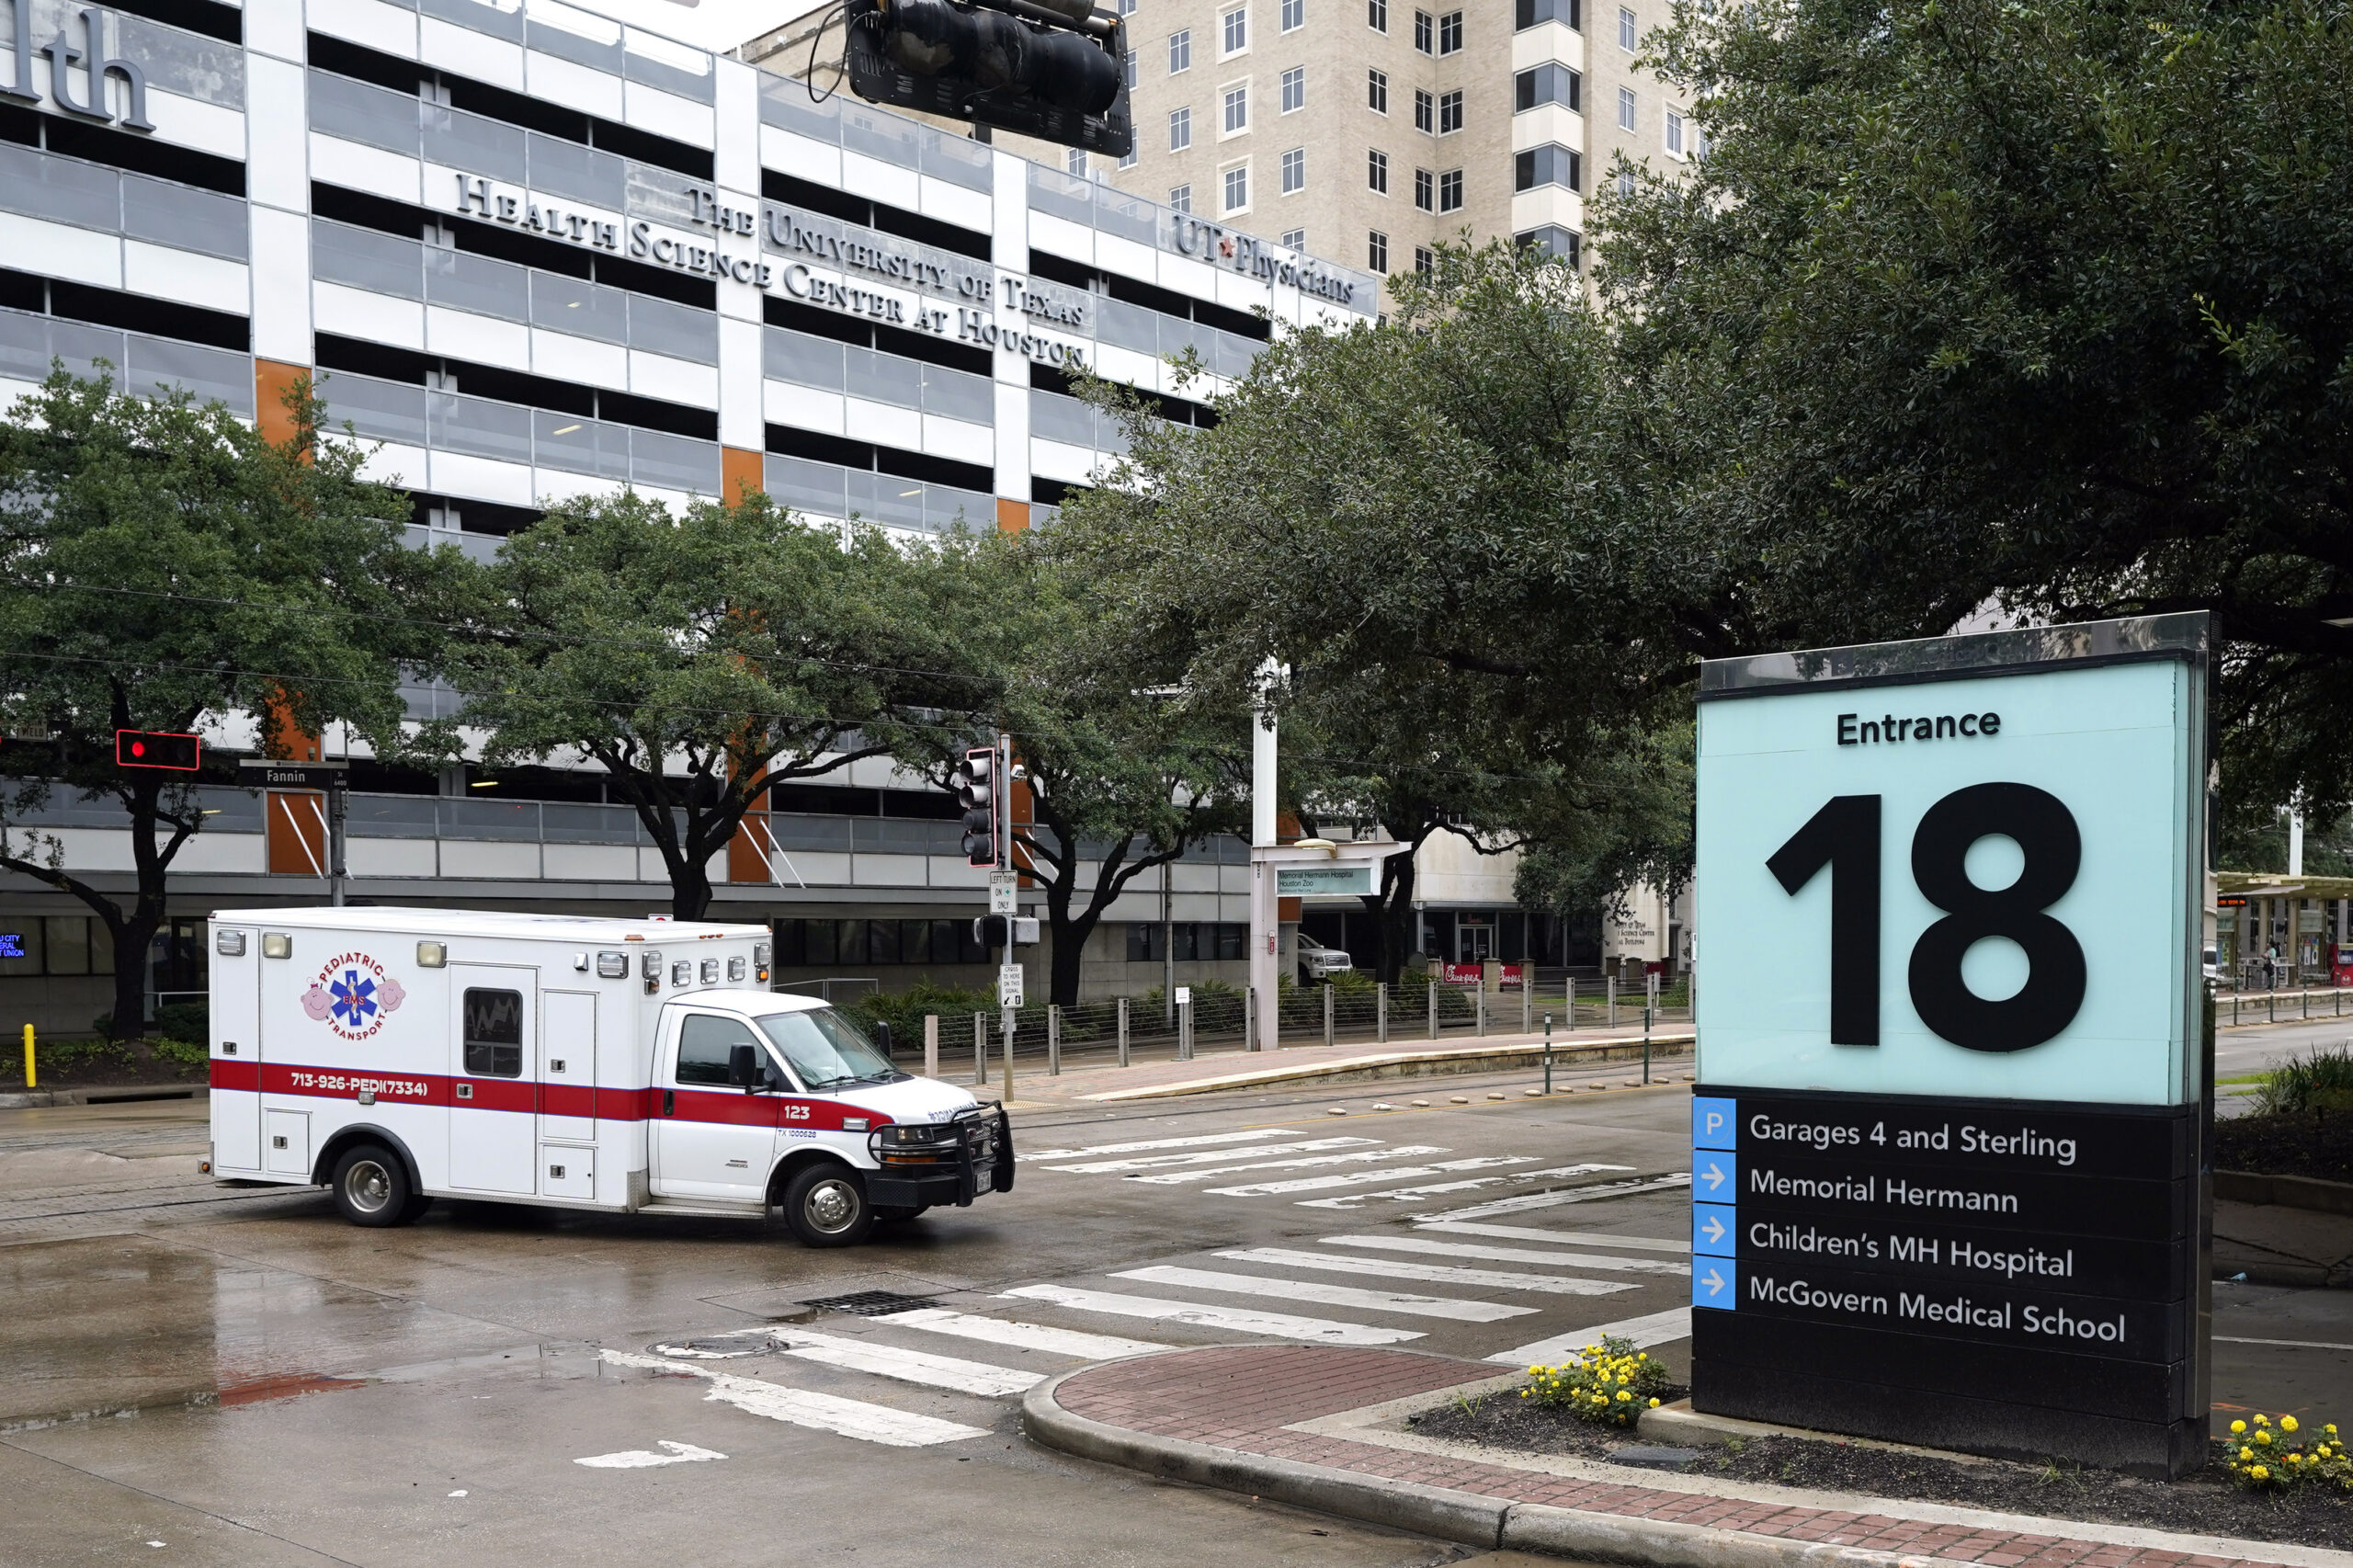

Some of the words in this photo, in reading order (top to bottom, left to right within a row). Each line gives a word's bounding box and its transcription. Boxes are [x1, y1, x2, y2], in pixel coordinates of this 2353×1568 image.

[685, 187, 756, 238] THE
[767, 210, 949, 290] UNIVERSITY
[959, 274, 993, 301] OF
[1001, 276, 1085, 326] TEXAS
[456, 174, 619, 249] HEALTH
[631, 222, 772, 289] SCIENCE
[783, 263, 905, 323] CENTER
[914, 306, 948, 332] AT
[958, 308, 1086, 367] HOUSTON
[1836, 712, 2001, 745] Entrance
[267, 769, 305, 782] Fannin
[992, 875, 1002, 883] LEFT
[1004, 875, 1016, 883] TURN
[1279, 871, 1303, 880] Memorial
[1331, 870, 1353, 880] Hospital
[1302, 879, 1313, 887] Zoo
[997, 901, 1009, 909] ONLY
[1765, 782, 2087, 1053] 18
[5, 934, 20, 942] CITY
[319, 952, 383, 982] PEDIATRIC
[343, 995, 366, 1005] EMS
[328, 1013, 385, 1040] TRANSPORT
[290, 1073, 427, 1096] 713-926-PEDI(7334)
[784, 1106, 810, 1119] 123
[1706, 1112, 1723, 1135] P
[1750, 1114, 1860, 1151] Garages
[1870, 1121, 1887, 1146] 4
[1896, 1123, 1949, 1151] and
[1960, 1125, 2077, 1165] Sterling
[1750, 1169, 1875, 1202] Memorial
[1886, 1179, 2018, 1213] Hermann
[1750, 1223, 1879, 1258] Children's
[1890, 1235, 1938, 1264] MH
[1950, 1242, 2073, 1278] Hospital
[1750, 1276, 1887, 1315] McGovern
[1899, 1292, 2011, 1329] Medical
[2023, 1306, 2125, 1342] School
